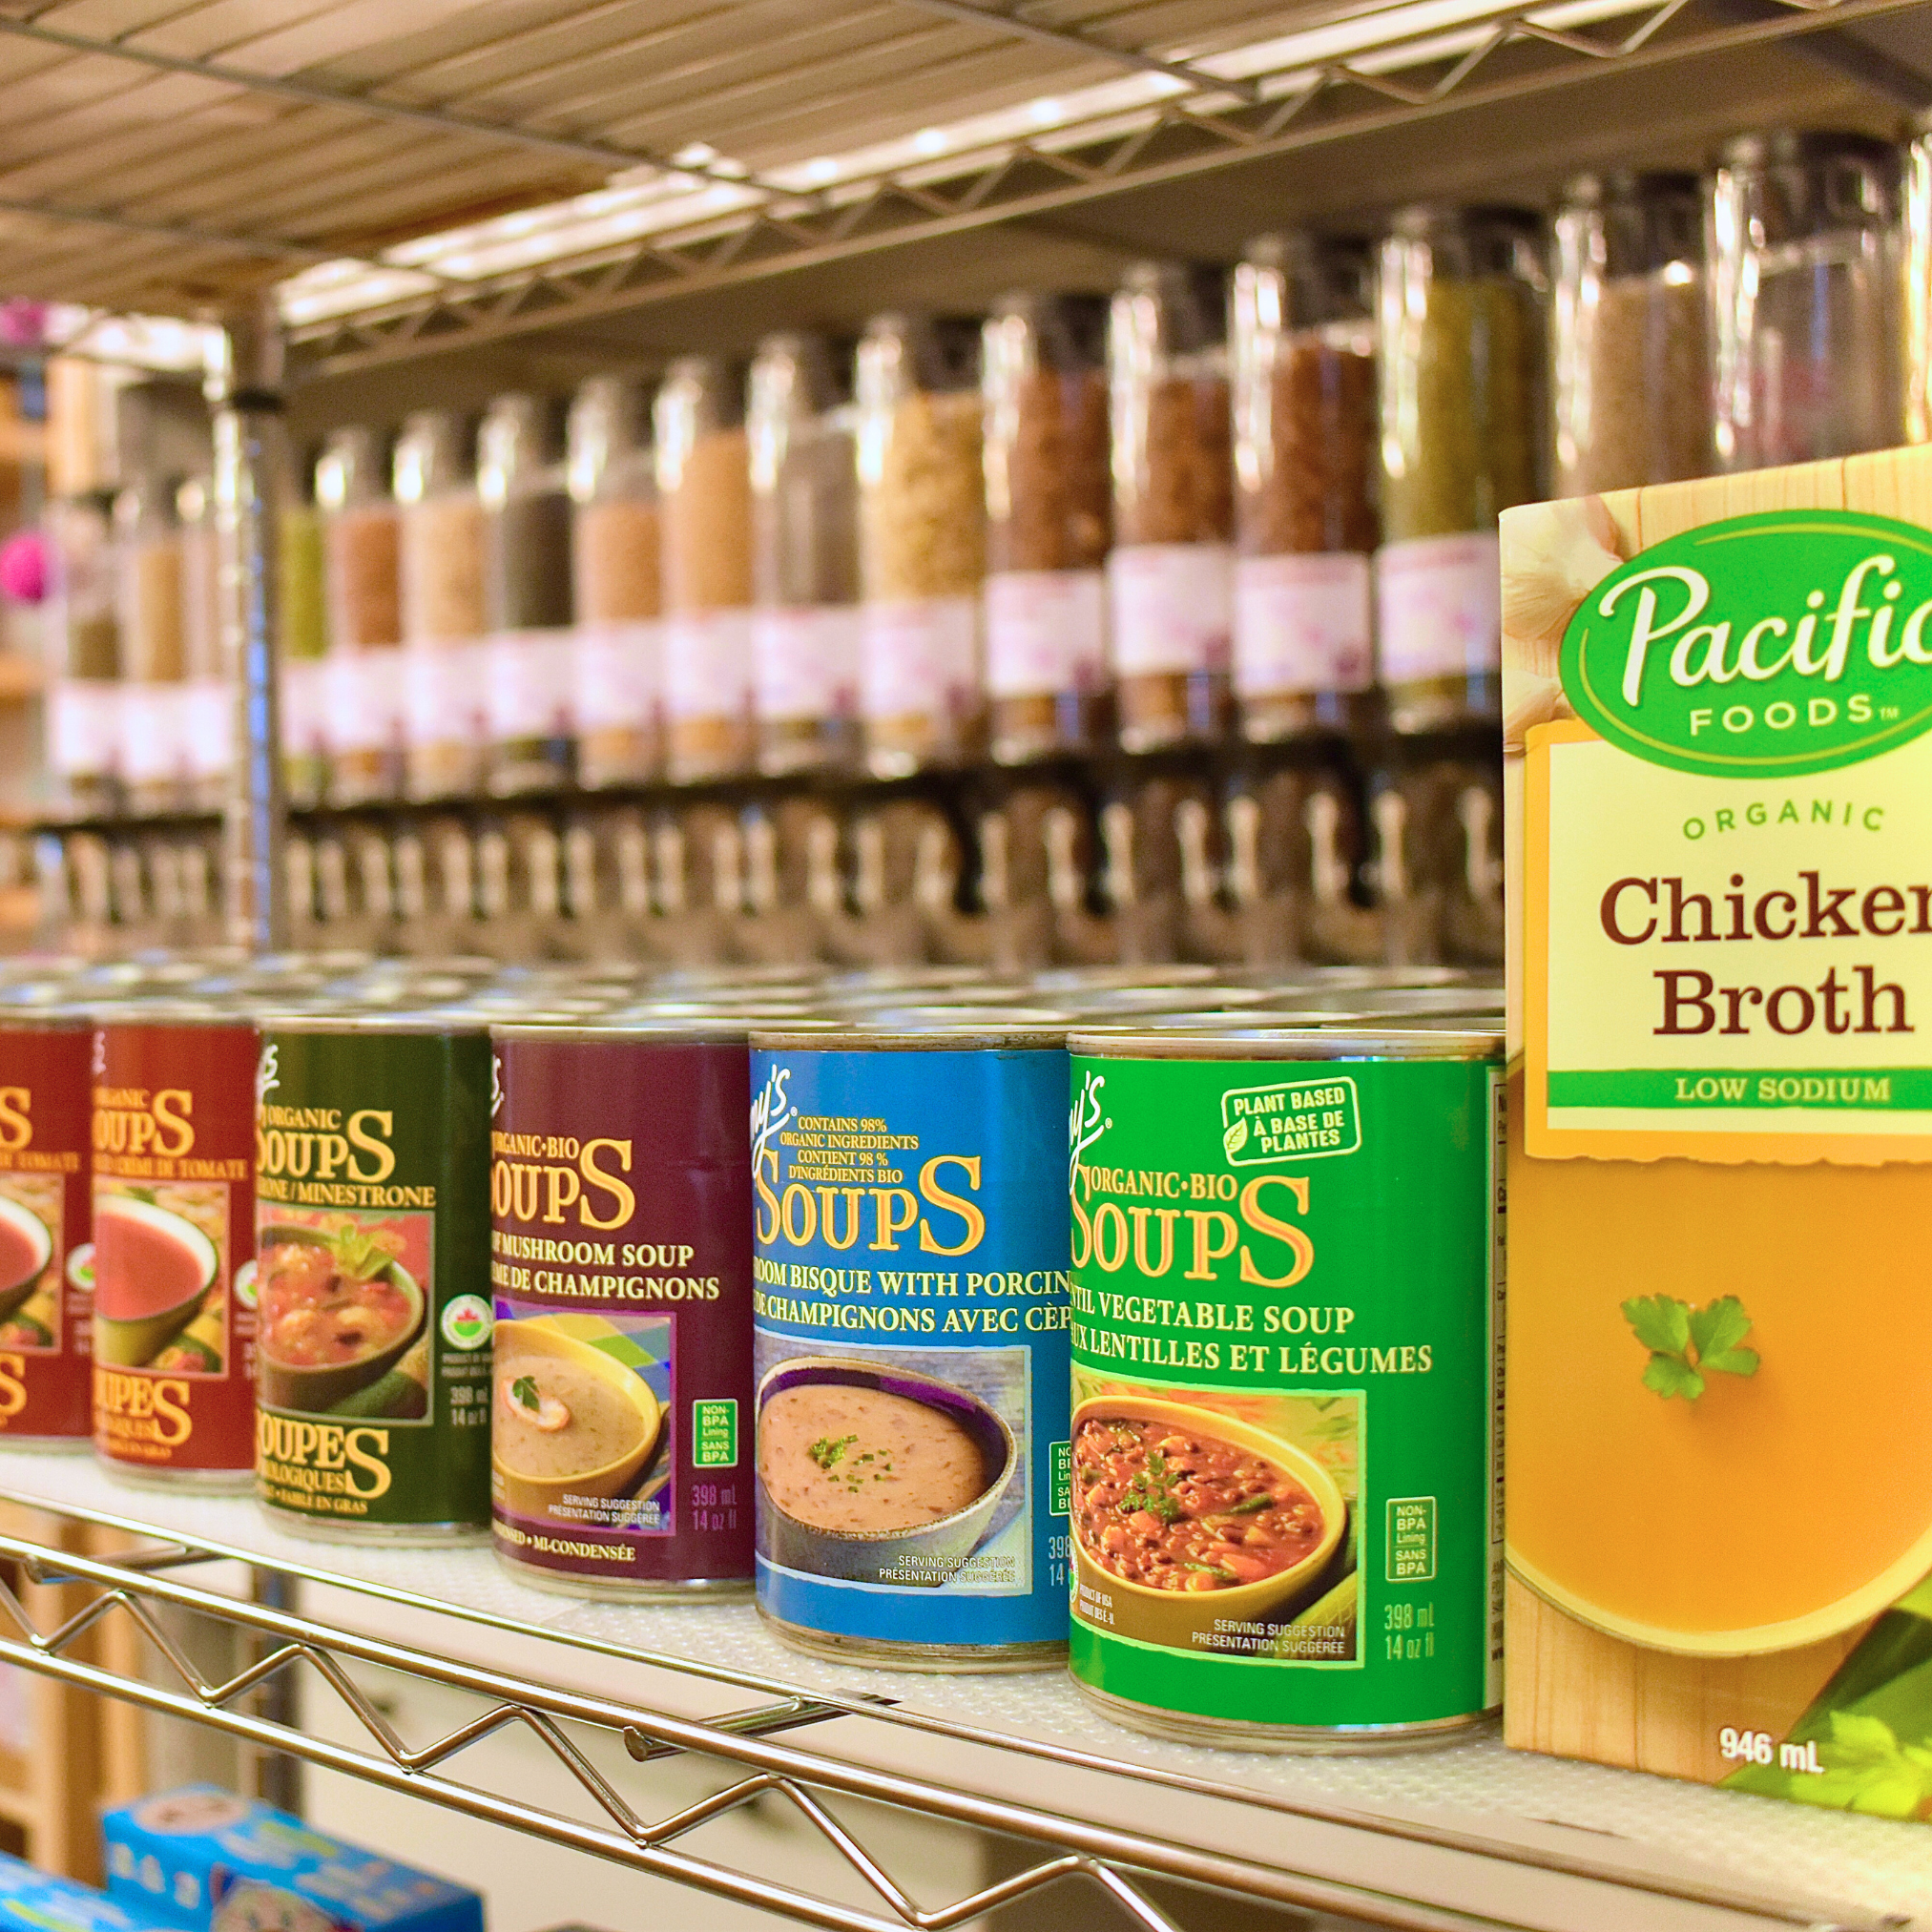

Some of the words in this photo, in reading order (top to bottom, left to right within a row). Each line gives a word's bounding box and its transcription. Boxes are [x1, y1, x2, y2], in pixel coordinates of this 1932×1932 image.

[1598, 555, 1932, 707] Pacific
[1689, 695, 1873, 737] FOODS
[1683, 799, 1884, 841] ORGANIC
[1652, 965, 1915, 1035] Broth
[1233, 1093, 1285, 1117] PLANT
[1291, 1086, 1345, 1111] BASED
[1675, 1077, 1748, 1101] LOW
[1758, 1077, 1891, 1102] SODIUM
[798, 1116, 858, 1132] CONTAINS
[861, 1117, 887, 1133] 98%
[1254, 1116, 1266, 1136] À
[1271, 1112, 1319, 1134] BASE
[1322, 1110, 1344, 1129] DE
[779, 1132, 825, 1149] ORGANIC
[827, 1134, 919, 1151] INGREDIENTS
[1261, 1129, 1340, 1153] PLANTES
[797, 1150, 857, 1166] CONTIENT
[859, 1152, 874, 1166] 98
[491, 1138, 636, 1231] OUPS
[877, 1169, 904, 1184] BIO
[298, 1181, 436, 1208] MINESTRONE
[755, 1148, 987, 1257] SOUPS
[1070, 1163, 1315, 1289] SOUPS
[502, 1233, 615, 1265] MUSHROOM
[622, 1244, 695, 1268] SOUP
[510, 1265, 531, 1291] DE
[534, 1270, 720, 1300] CHAMPIGNONS
[790, 1264, 871, 1298] BISQUE
[878, 1271, 962, 1296] WITH
[966, 1271, 1070, 1296] PORCIN
[767, 1296, 935, 1333] CHAMPIGNONS
[942, 1308, 1018, 1333] AVEC
[1098, 1292, 1254, 1332] VEGETABLE
[1264, 1305, 1355, 1334] SOUP
[1091, 1328, 1220, 1371] LENTILLES
[1230, 1344, 1269, 1372] ET
[1278, 1342, 1432, 1375] LÉGUMES
[702, 1416, 729, 1427] BPA
[701, 1441, 730, 1451] SANS
[702, 1451, 729, 1463] BPA
[563, 1493, 599, 1508] SERVING
[600, 1497, 660, 1512] SUGGESTION
[692, 1485, 717, 1506] 398
[693, 1509, 708, 1531] 14
[1396, 1517, 1426, 1531] BPA
[899, 1555, 944, 1568] SERVING
[946, 1557, 1015, 1568] SUGGESTION
[1395, 1549, 1427, 1562] SANS
[1396, 1562, 1426, 1575] BPA
[1050, 1563, 1064, 1587] 14
[1214, 1619, 1265, 1636] SERVING
[1267, 1622, 1345, 1639] SUGGESTION
[1384, 1603, 1414, 1631] 398
[1385, 1633, 1403, 1660] 14
[1719, 1727, 1773, 1764] 946
[1779, 1740, 1825, 1775] mL
